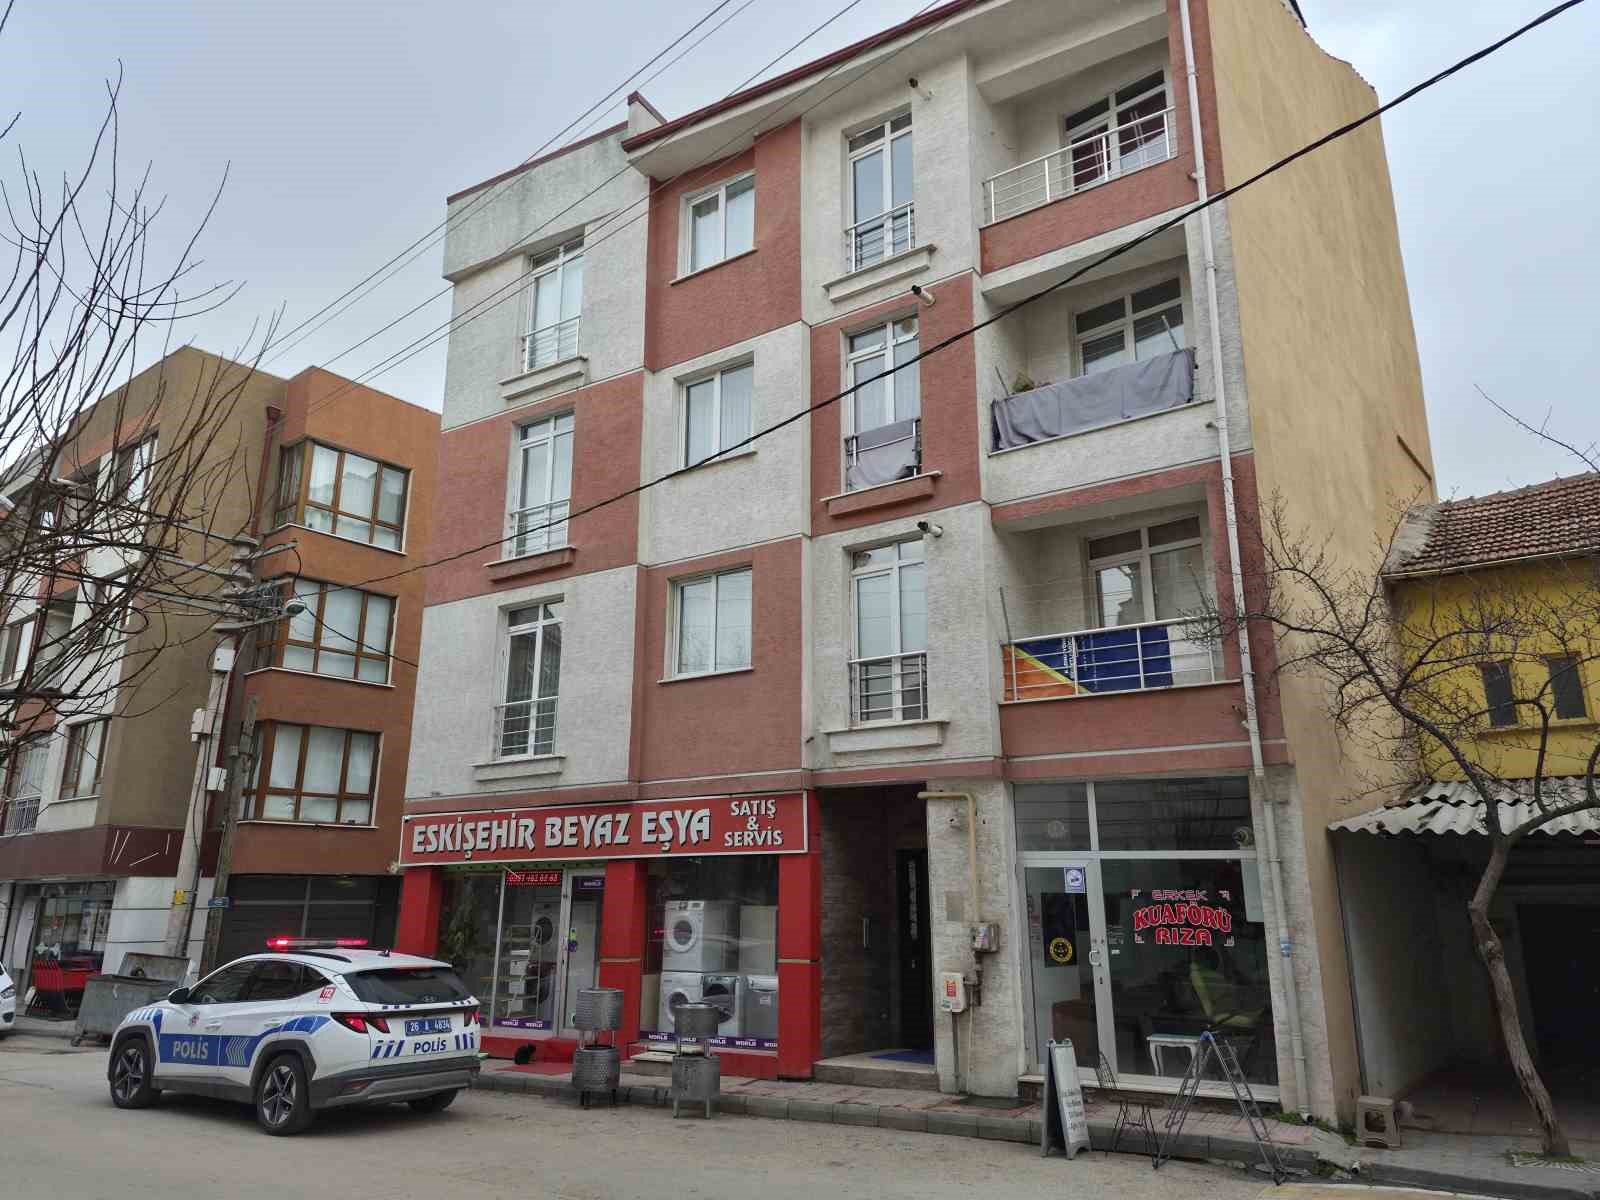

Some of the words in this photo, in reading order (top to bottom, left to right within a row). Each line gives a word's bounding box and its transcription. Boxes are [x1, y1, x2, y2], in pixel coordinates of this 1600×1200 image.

[729, 799, 776, 818] SATIŞ
[746, 816, 760, 831] &
[411, 812, 536, 859] ESKİŞEHİR
[544, 813, 630, 849] BEYAZ
[640, 808, 711, 851] EŞYA
[724, 826, 783, 847] SERVİS
[1152, 889, 1209, 901] ERKEK
[1134, 901, 1232, 933] KUAFÖRÜ
[1154, 927, 1213, 946] RIZA
[410, 1021, 420, 1033] 26
[172, 1036, 209, 1060] POLİS
[413, 1036, 448, 1055] POLİS
